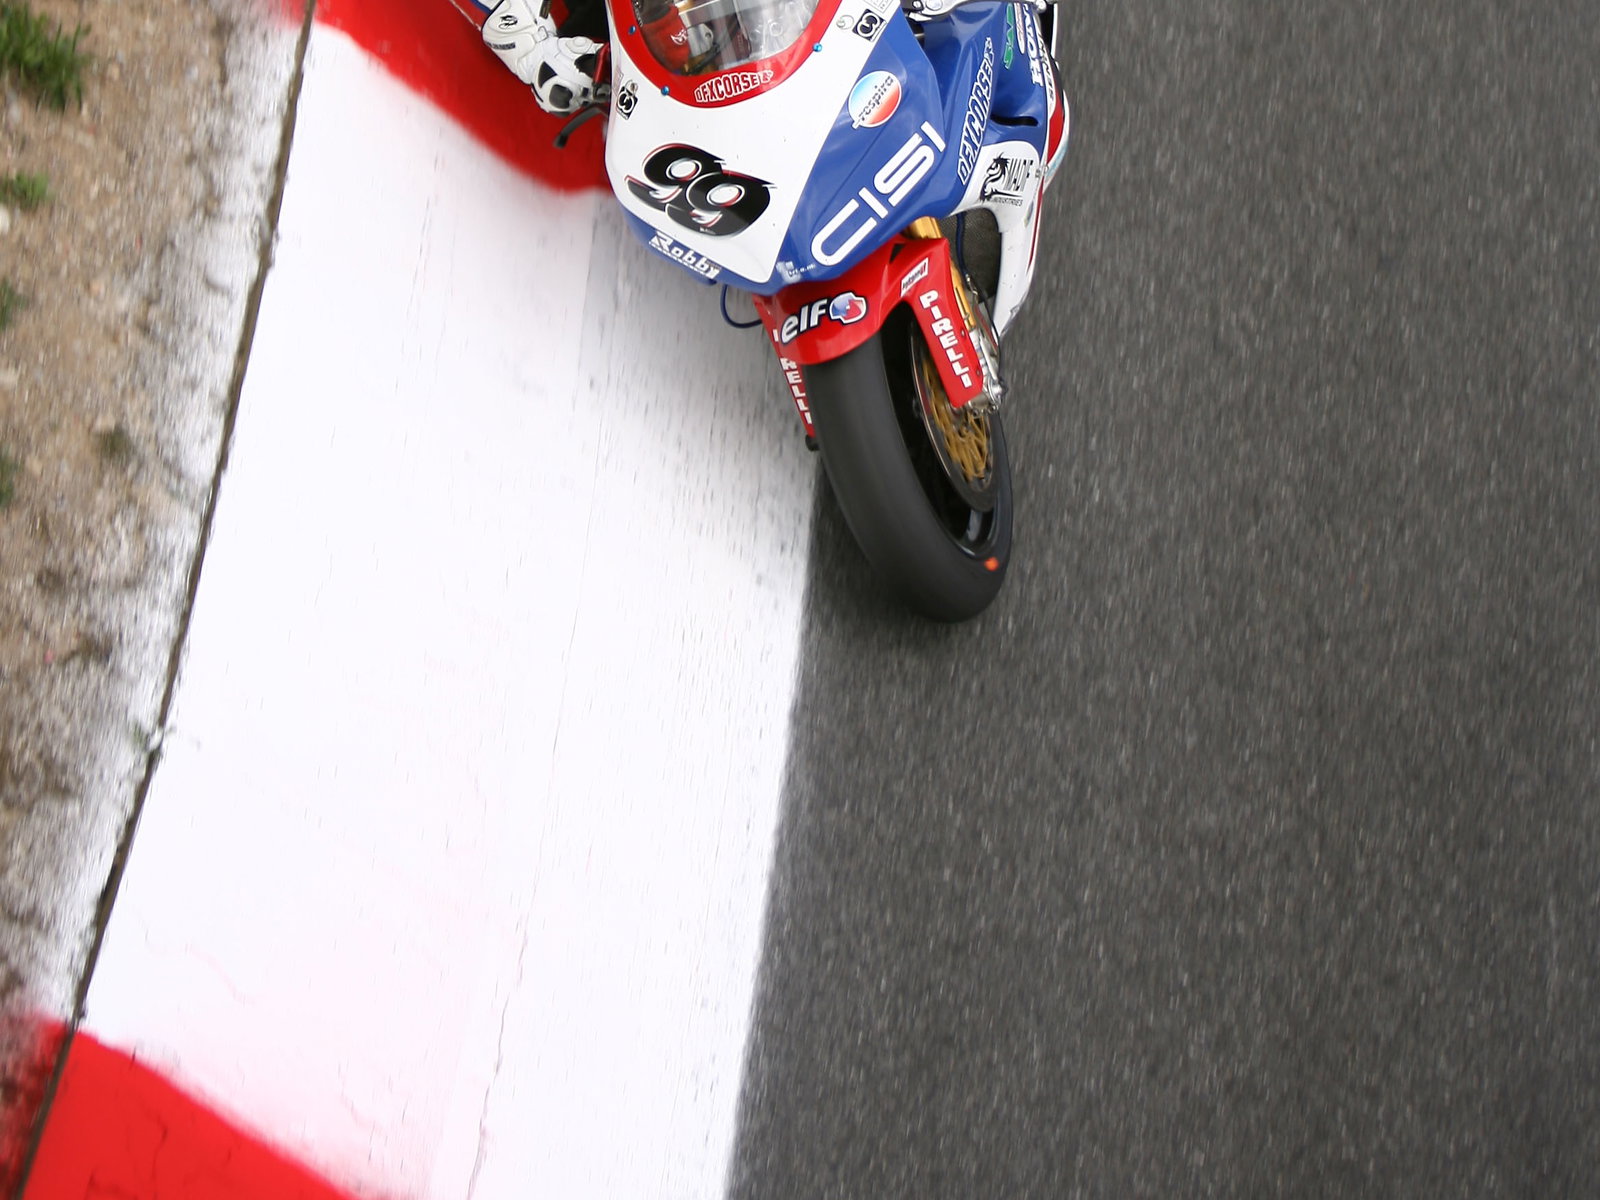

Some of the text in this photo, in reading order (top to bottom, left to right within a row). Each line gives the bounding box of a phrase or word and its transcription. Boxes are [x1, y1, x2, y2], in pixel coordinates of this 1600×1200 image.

[624, 142, 777, 237] 99
[649, 230, 722, 278] Robby
[782, 298, 828, 344] elf
[919, 290, 972, 389] PIRELLI
[773, 328, 812, 425] IRELLI
